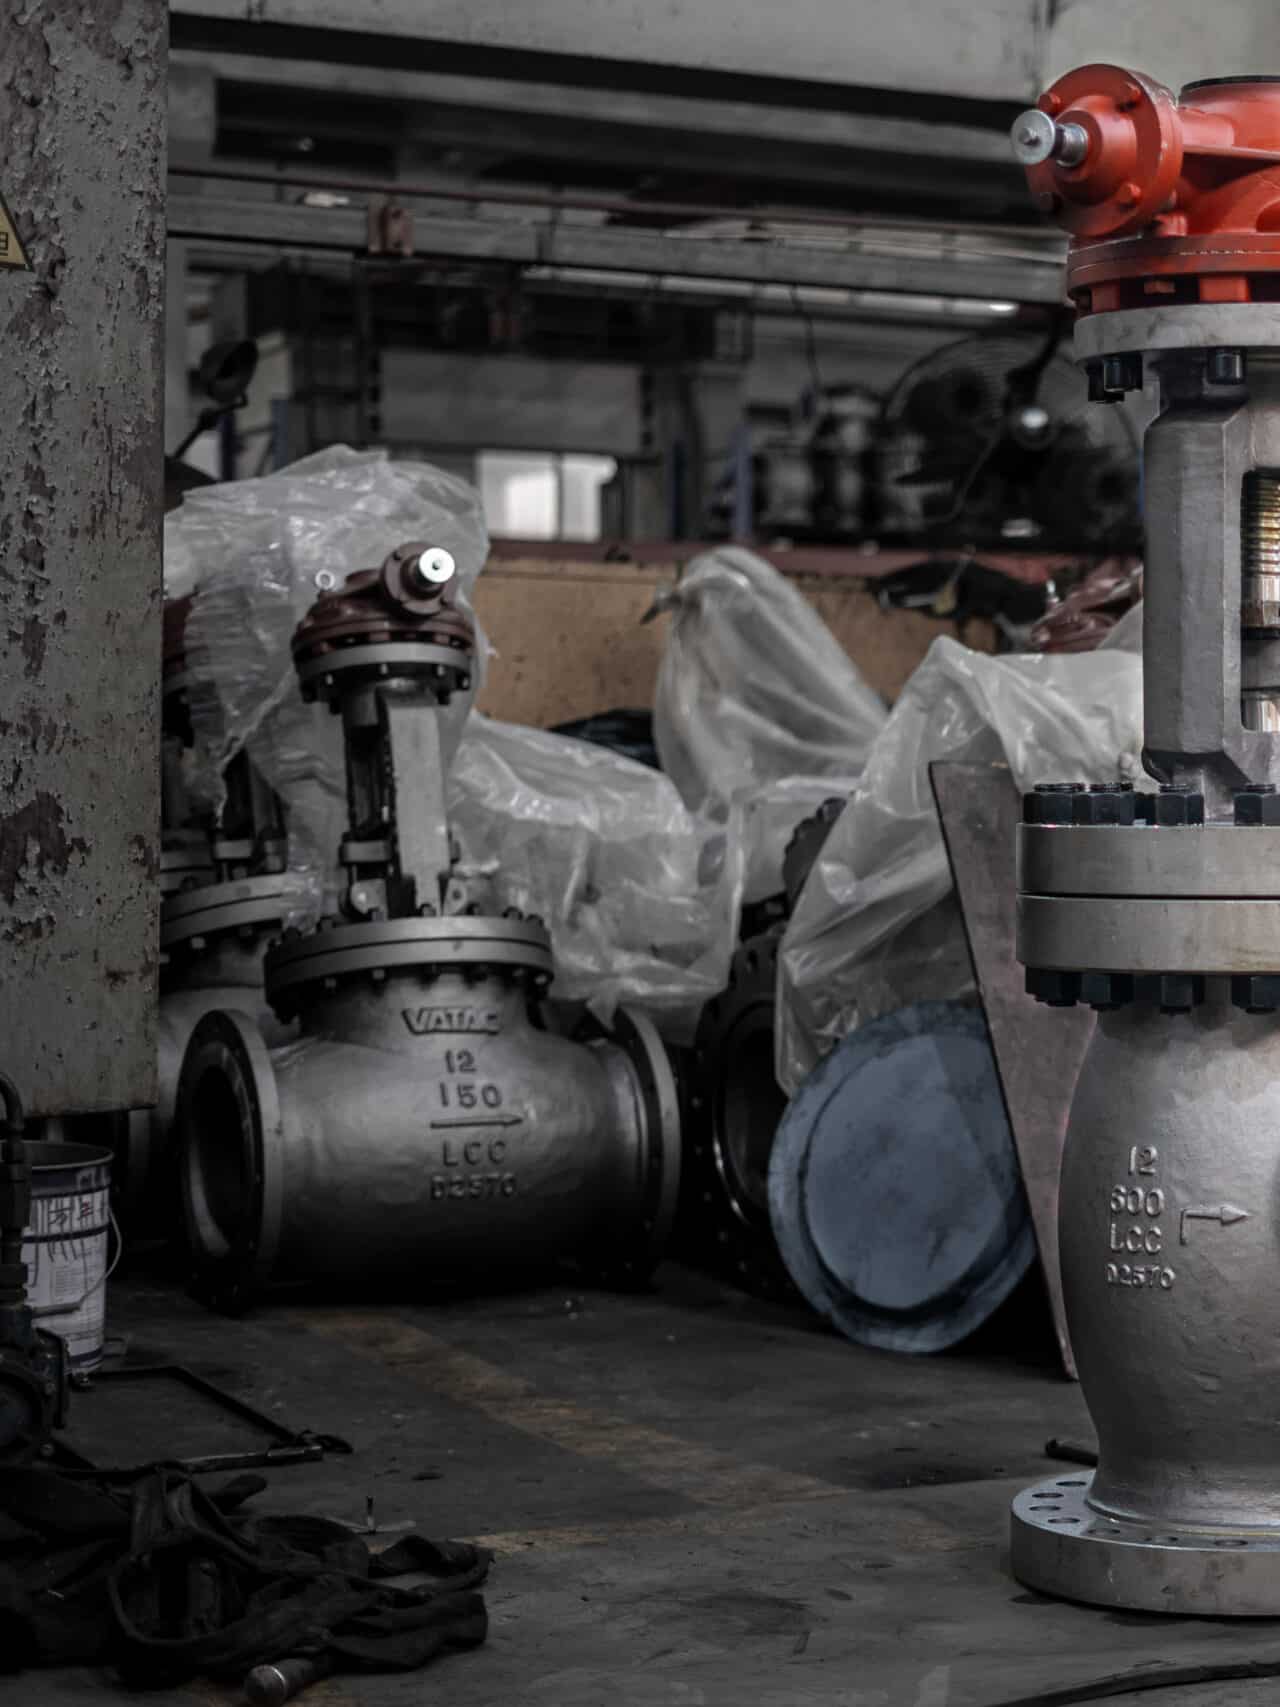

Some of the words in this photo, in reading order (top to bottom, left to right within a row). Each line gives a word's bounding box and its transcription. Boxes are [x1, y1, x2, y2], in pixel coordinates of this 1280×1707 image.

[445, 1050, 478, 1074] 12
[439, 1081, 503, 1109] 150
[442, 1139, 507, 1168] LCC
[1128, 1145, 1159, 1176] 12
[1109, 1183, 1166, 1217] 600
[1109, 1222, 1163, 1255] LCC
